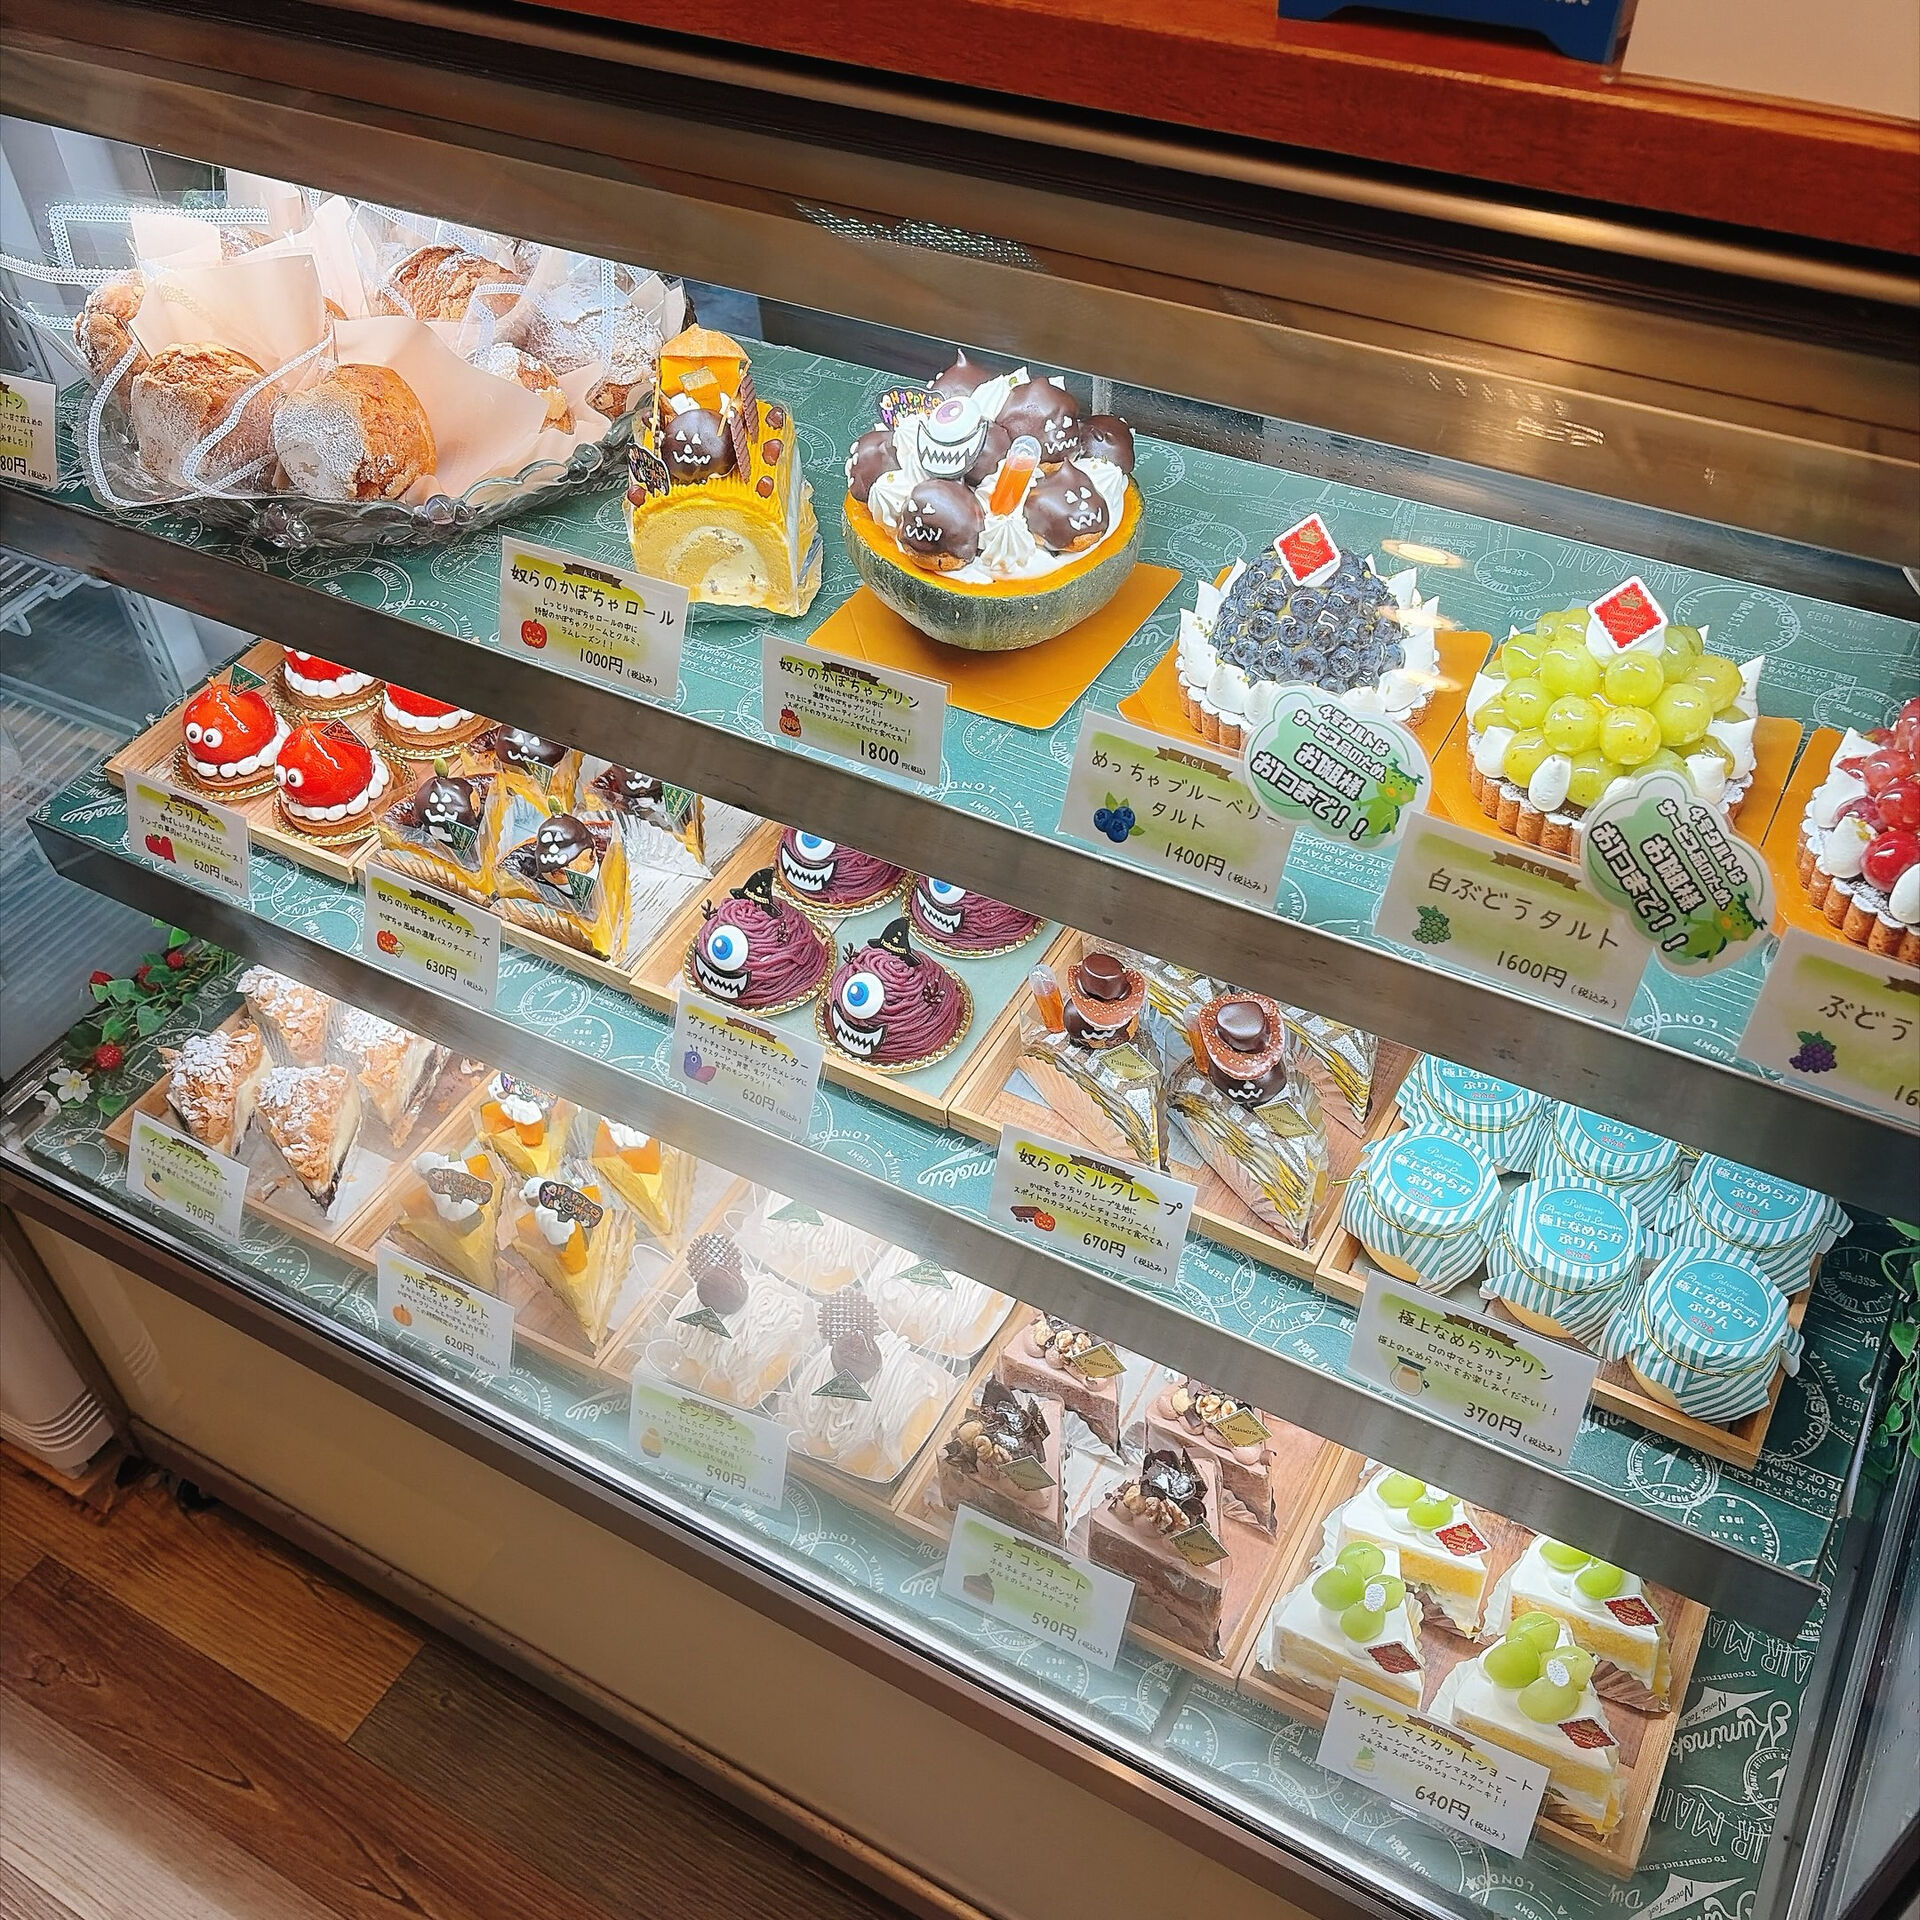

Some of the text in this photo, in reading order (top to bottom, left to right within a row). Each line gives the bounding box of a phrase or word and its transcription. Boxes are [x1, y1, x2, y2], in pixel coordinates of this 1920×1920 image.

[511, 564, 674, 625] 奴らのかぼちゃロール
[543, 598, 638, 633] しっとりかぼちゃロールの中に
[1506, 605, 1541, 621] Diy
[579, 648, 658, 686] 1000円 (税込み)
[779, 657, 919, 709] 奴らのかぼちゃプリン
[1319, 704, 1389, 756] 4号タルトは
[860, 739, 899, 766] 1800
[1292, 709, 1386, 784] サービス品のため、
[164, 802, 219, 831] スラりんご
[1151, 802, 1206, 831] タルト
[1303, 848, 1332, 862] STAY
[1349, 852, 1365, 861] OF
[1689, 806, 1747, 885] 4号タルトは
[194, 859, 220, 879] 620円
[1165, 841, 1268, 895] 1400円 (税込み)
[1334, 858, 1364, 871] DAYS
[377, 891, 490, 947] 奴らのかぼちゃバスクチーズ
[1428, 868, 1618, 949] 白ぶどうタルト
[426, 959, 457, 981] 630円
[1496, 950, 1617, 1008] 1600円 (税込み)
[688, 1014, 808, 1070] ヴァイオレットモンスター
[1693, 1038, 1736, 1063] FLIGHT
[743, 1089, 775, 1112] 620円
[1463, 1081, 1503, 1092] ぷりん
[1895, 1085, 1920, 1106] 16
[1597, 1122, 1636, 1143] ぷりん
[150, 1138, 227, 1181] インディアンサマー
[1395, 1154, 1472, 1195] 極上なめらか
[1018, 1148, 1183, 1216] 奴らのミルクレープ
[1407, 1173, 1445, 1198] ぷりん
[1715, 1166, 1799, 1206] 極上なめらか
[186, 1202, 215, 1225] 590円
[1730, 1186, 1772, 1210] ぷりん
[1539, 1213, 1624, 1244] 極上なめらか
[1558, 1232, 1600, 1253] ぷりん
[1083, 1233, 1167, 1275] 670円 (税込み)
[404, 1273, 489, 1319] かぼちゃタルト
[1675, 1279, 1758, 1328] 極上なめらか
[1688, 1301, 1728, 1330] ぷりん
[445, 1335, 474, 1356] 620円
[1398, 1309, 1554, 1381] 極上なめらかプリン
[678, 1402, 736, 1431] モンブラン
[1464, 1402, 1562, 1457] 370円 (税込み)
[706, 1465, 746, 1489] 590円
[994, 1542, 1086, 1590] チョコショート
[1032, 1612, 1076, 1642] 590円
[1344, 1699, 1533, 1792] シャインマスカットショート
[1671, 1701, 1791, 1762] Kumimok
[1415, 1786, 1505, 1841] 640円 (税込み)
[1662, 1857, 1713, 1870] construct
[1608, 1884, 1644, 1909] Diy
